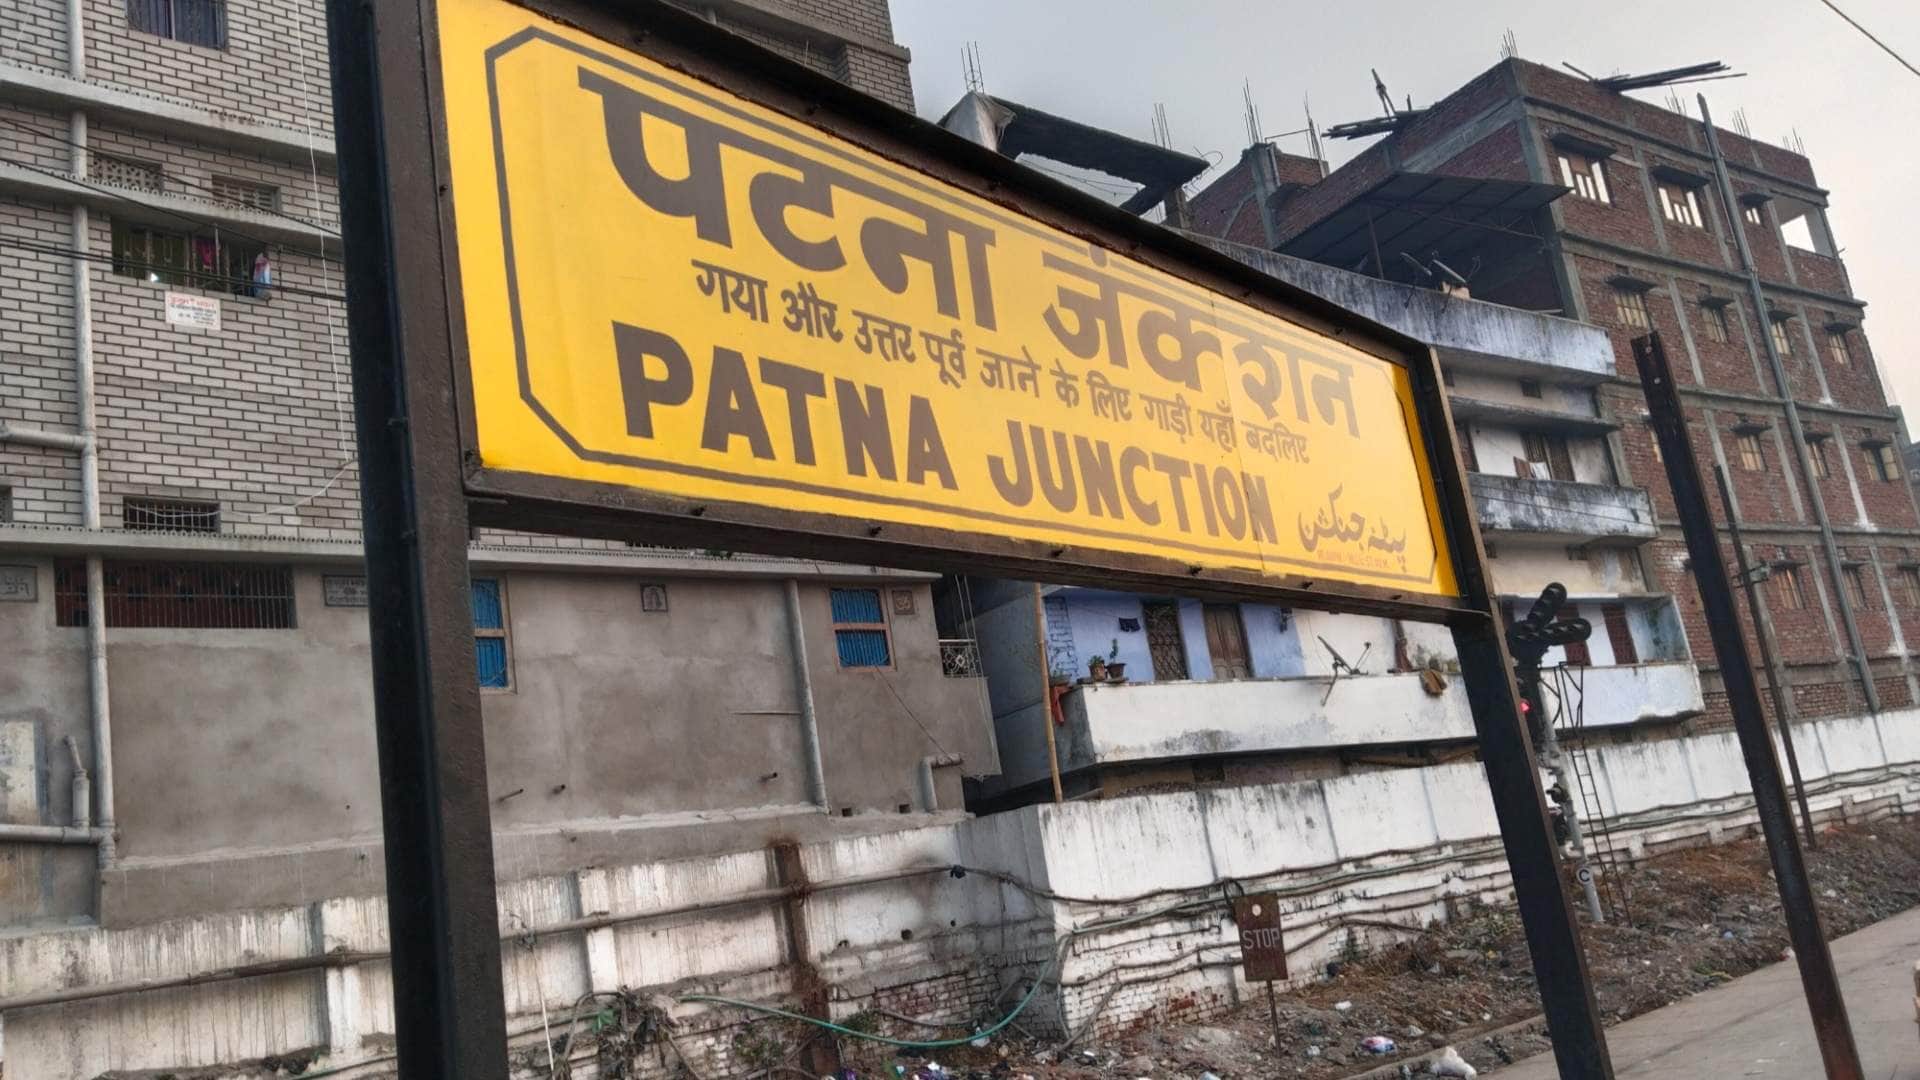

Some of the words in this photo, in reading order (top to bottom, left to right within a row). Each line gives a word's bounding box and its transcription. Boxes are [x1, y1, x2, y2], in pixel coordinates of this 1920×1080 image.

[577, 65, 997, 332] पटना
[1042, 244, 1360, 439] जंकशन
[611, 320, 959, 491] PATNA
[987, 418, 1278, 546] JUNCTION
[691, 258, 769, 324] गया
[781, 280, 844, 344] और
[852, 309, 917, 363] उत्तर
[919, 328, 967, 389] पूर्व
[975, 345, 1042, 398] जाने
[1050, 358, 1080, 408] के
[1086, 370, 1133, 422] लिए
[1139, 392, 1194, 444] गाड़ी
[1197, 400, 1238, 453] यहाँ
[1241, 421, 1311, 464] बदलिए
[1242, 927, 1280, 950] STOP
[1579, 869, 1590, 882] C
